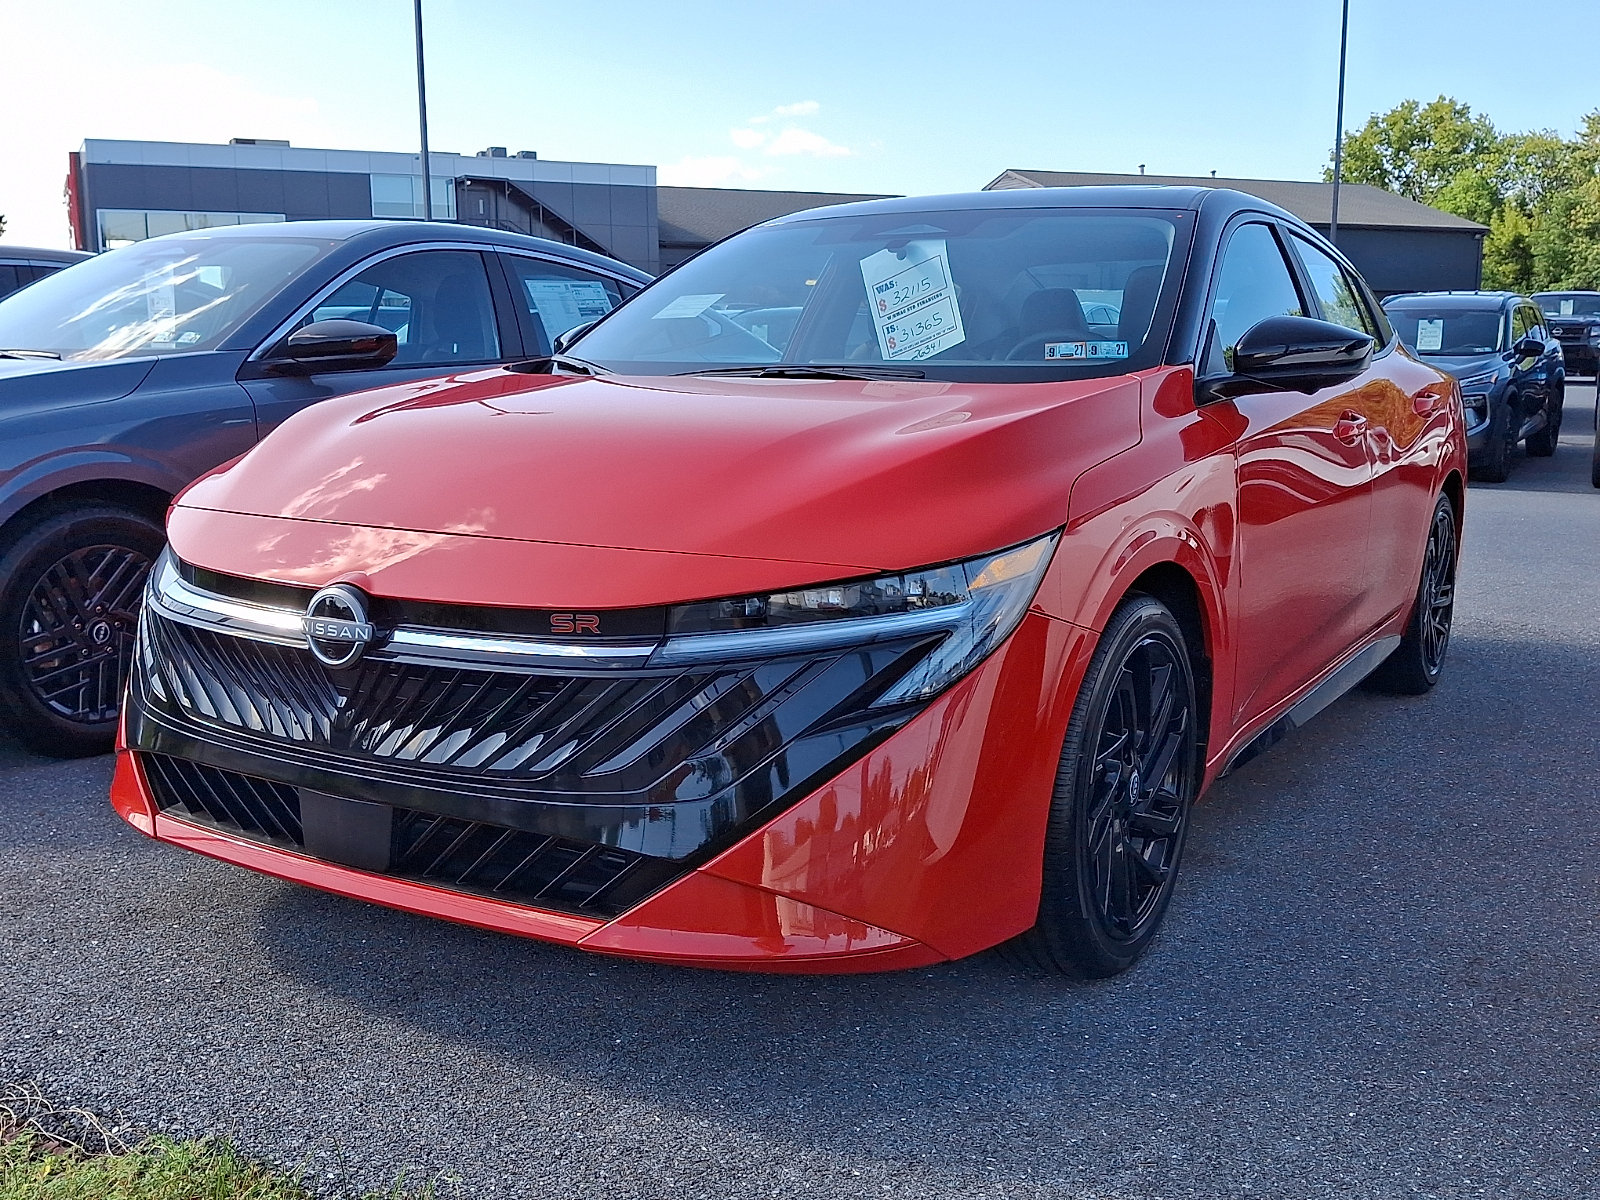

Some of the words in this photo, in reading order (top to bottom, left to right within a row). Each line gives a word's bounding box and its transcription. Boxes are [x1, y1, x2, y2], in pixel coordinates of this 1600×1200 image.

[875, 280, 898, 294] WAS:
[892, 277, 931, 306] 32115
[917, 292, 943, 308] FINANCING
[885, 324, 899, 335] IS:
[899, 311, 943, 342] 31365
[1048, 347, 1055, 357] 9
[1074, 344, 1083, 356] 27
[1090, 345, 1097, 355] 9
[1115, 343, 1125, 355] 27
[301, 620, 369, 640] NISSAN
[550, 613, 601, 633] SR
